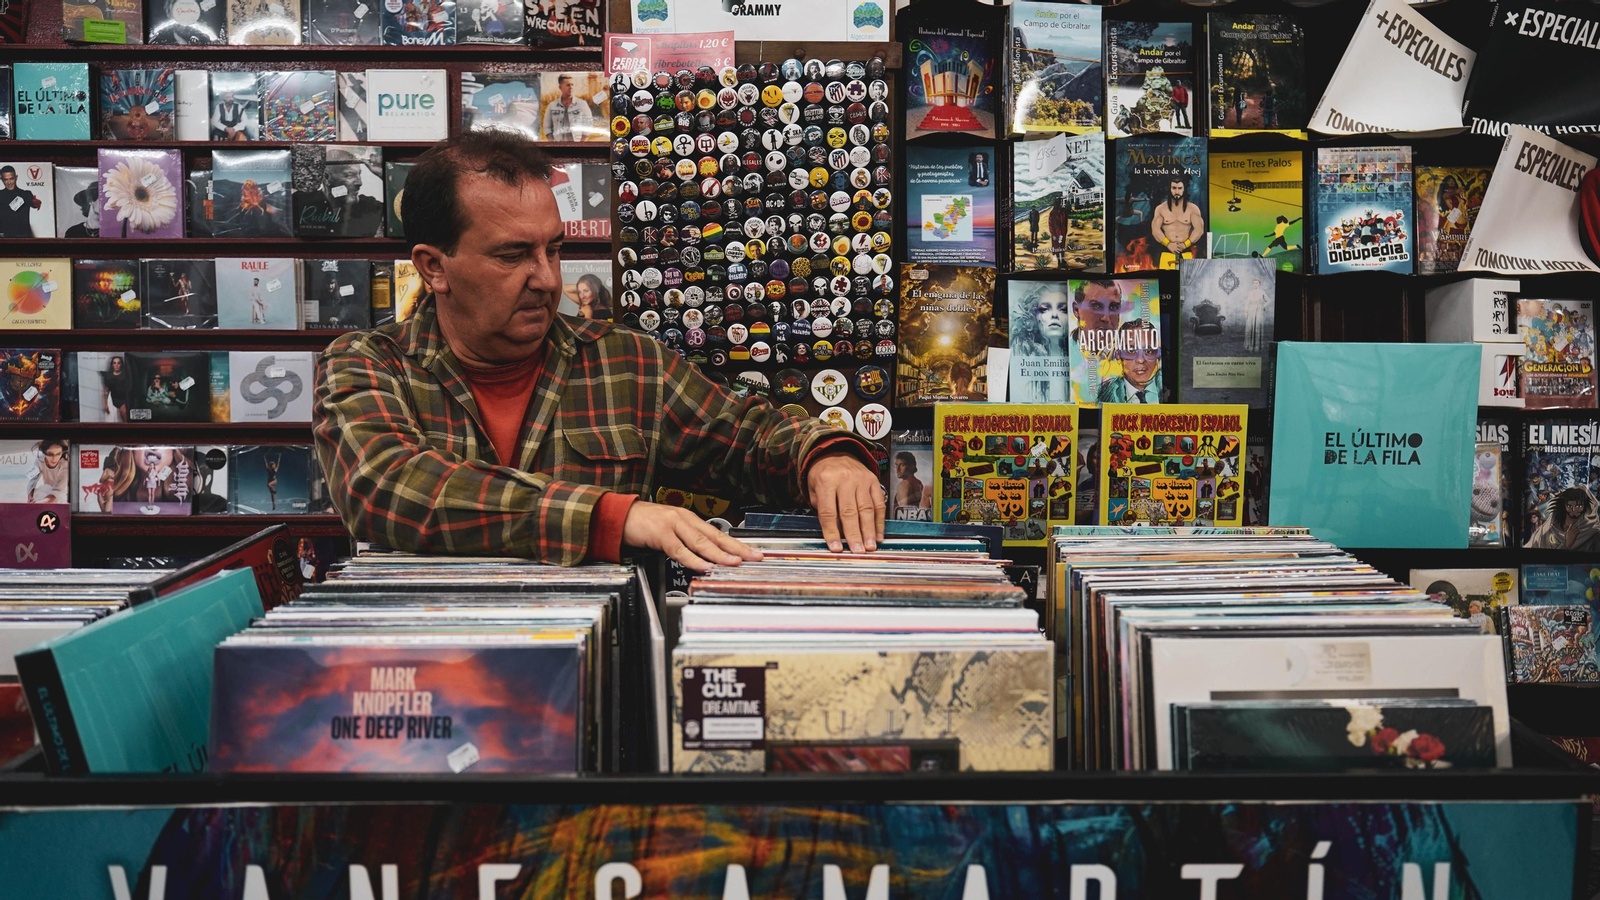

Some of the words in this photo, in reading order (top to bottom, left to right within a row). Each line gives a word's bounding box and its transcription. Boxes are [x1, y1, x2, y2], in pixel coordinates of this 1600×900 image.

[731, 4, 782, 17] GRAMMY
[1035, 10, 1058, 18] Andar
[1060, 12, 1072, 20] por
[526, 15, 579, 35] WRECKING
[580, 24, 602, 38] BALL
[1024, 19, 1048, 28] Campo
[1050, 20, 1059, 28] de
[1061, 21, 1091, 30] Gibraltar
[1232, 22, 1255, 31] Andar
[1255, 24, 1269, 32] por
[936, 27, 944, 35] del
[1220, 31, 1243, 40] Campo
[1244, 31, 1257, 39] de
[1258, 31, 1292, 40] Gibraltar
[699, 38, 719, 49] 1,20
[721, 38, 729, 48] €
[1110, 27, 1118, 80] Excursionista
[1139, 48, 1164, 56] Andar
[714, 58, 721, 67] 3
[724, 57, 731, 67] €
[1134, 57, 1154, 65] Campo
[18, 91, 32, 102] EL
[35, 88, 87, 102] ÚLTIMO
[18, 104, 34, 114] DE
[38, 103, 56, 114] LA
[58, 103, 87, 114] FILA
[378, 92, 435, 117] pure
[1221, 159, 1246, 169] Entre
[1248, 158, 1265, 168] Tres
[1268, 158, 1292, 167] Palos
[1514, 141, 1587, 192] ESPECIALES
[1143, 167, 1169, 178] leyenda
[1333, 242, 1342, 250] la
[1328, 243, 1404, 264] Dibupedia
[1474, 248, 1542, 270] TOMOYUKI
[1541, 259, 1592, 271] HOTTA
[241, 261, 269, 270] RAULE
[584, 263, 612, 273] Montil
[912, 289, 922, 298] El
[923, 291, 957, 300] enigma
[960, 291, 970, 299] de
[973, 292, 986, 300] las
[920, 304, 944, 312] niñas
[946, 304, 976, 312] dobles
[1080, 328, 1159, 351] ARGOMENTO
[876, 346, 896, 354] LOKI
[1020, 359, 1041, 368] Juan
[1043, 359, 1070, 368] Emilio
[944, 414, 971, 433] ROCK
[972, 413, 1030, 433] PROGRESIVO
[1032, 414, 1073, 433] ESPAÑOL
[1112, 414, 1139, 433] ROCK
[1140, 413, 1199, 433] PROGRESIVO
[1200, 414, 1242, 432] ESPAÑOL
[1324, 432, 1346, 447] EL
[1351, 428, 1423, 447] ÚLTIMO
[1529, 425, 1548, 444] EL
[1544, 446, 1590, 455] Historietas
[1324, 449, 1348, 465] DE
[1353, 449, 1377, 465] LA
[1382, 449, 1421, 465] FILA
[896, 509, 928, 520] NBA
[673, 576, 688, 587] NÁ
[371, 667, 416, 691] MARK
[702, 668, 737, 683] THE
[702, 683, 746, 698] CULT
[353, 691, 433, 716] KNOPFLER
[703, 700, 761, 715] DREAMTIME
[331, 716, 361, 740] ONE
[365, 717, 403, 740] DEEP
[407, 716, 452, 740] RIVER
